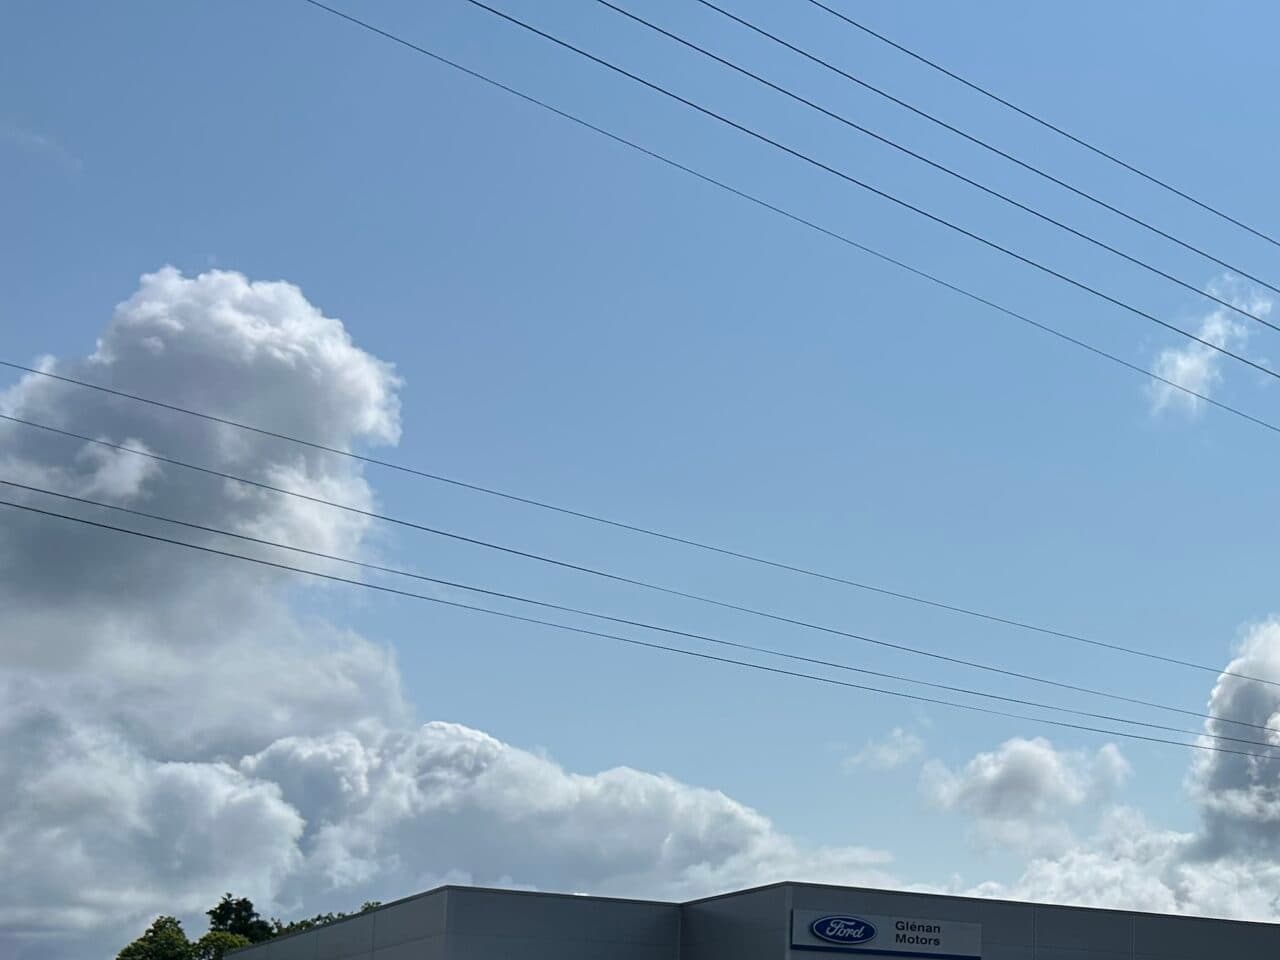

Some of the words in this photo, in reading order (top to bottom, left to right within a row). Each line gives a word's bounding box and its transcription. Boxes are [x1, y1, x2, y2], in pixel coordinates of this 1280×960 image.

[825, 919, 865, 938] Ford
[895, 920, 941, 934] Glénan
[895, 933, 941, 946] Motors
